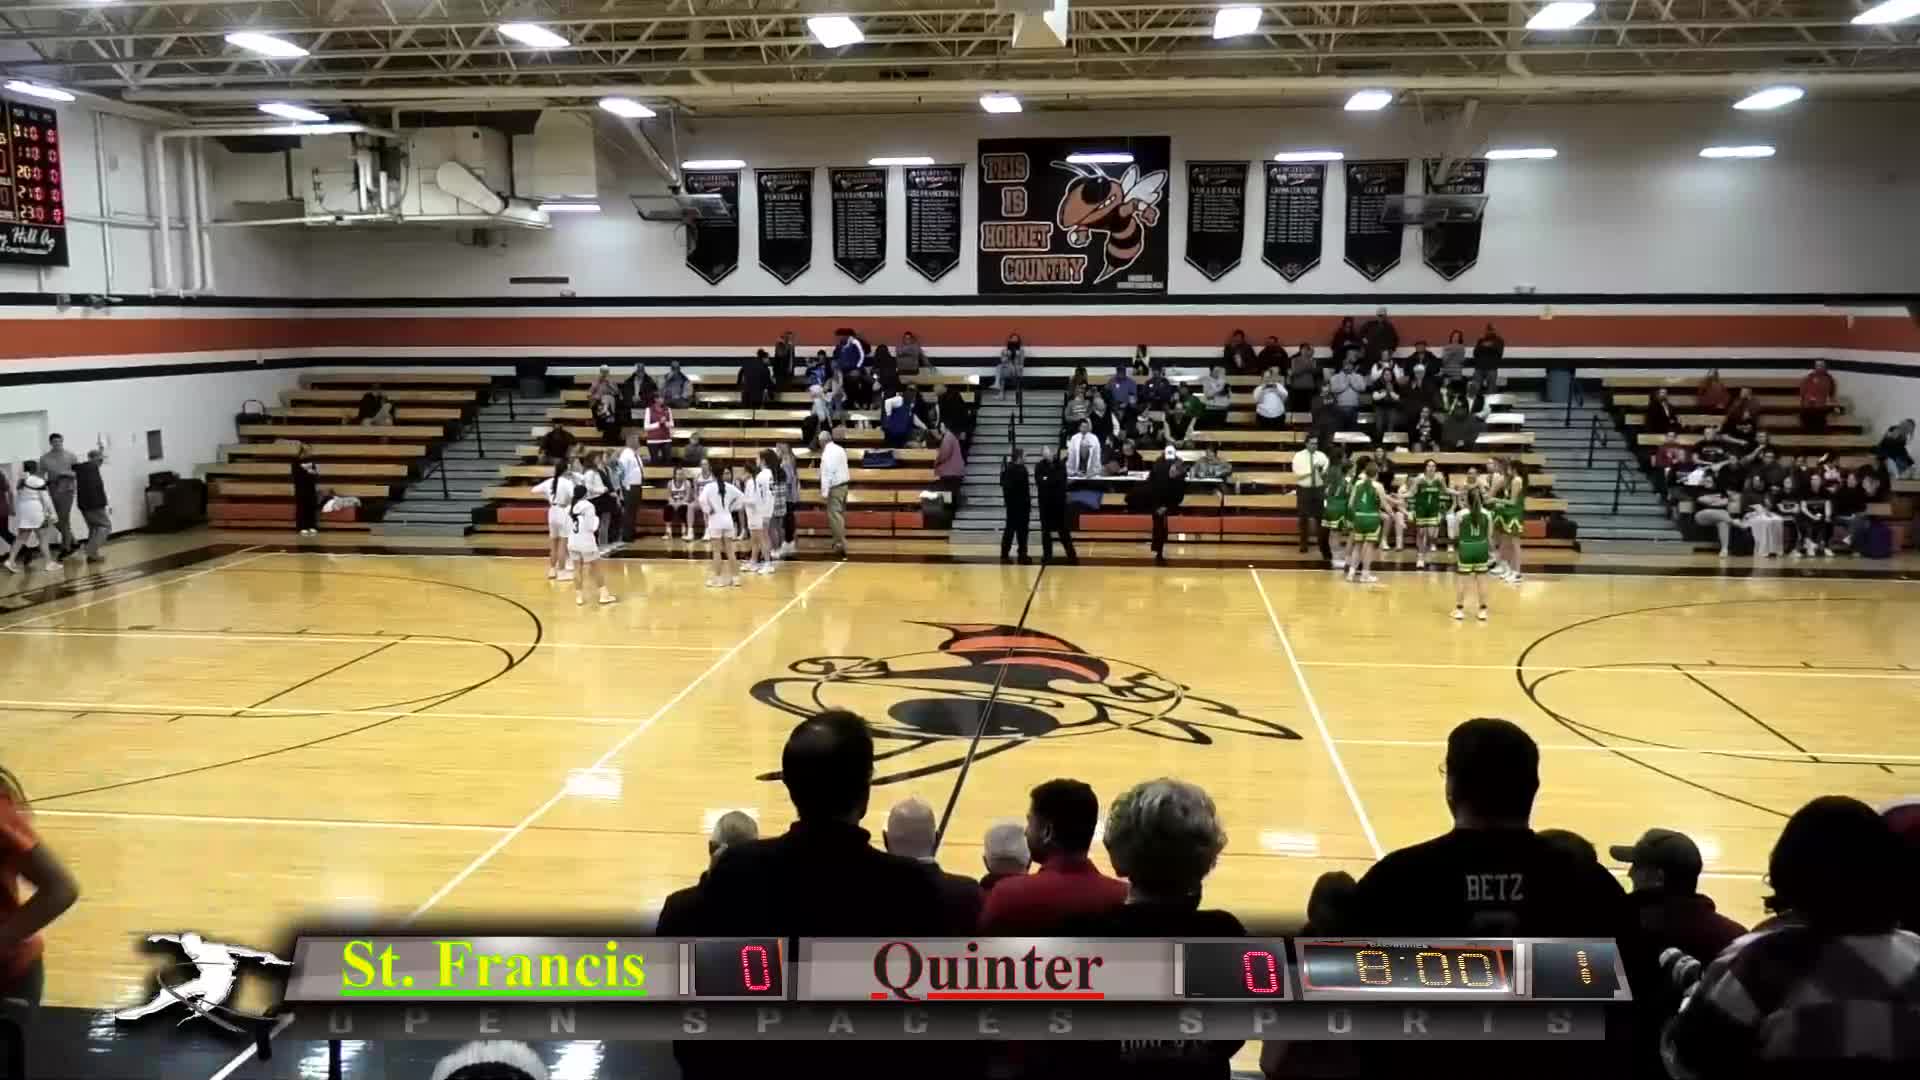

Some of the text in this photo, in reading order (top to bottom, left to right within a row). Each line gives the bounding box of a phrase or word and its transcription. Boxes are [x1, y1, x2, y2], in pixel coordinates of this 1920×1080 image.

[984, 225, 1050, 249] HORNET
[1004, 258, 1084, 282] COUNTRY
[1466, 873, 1525, 901] BETZ
